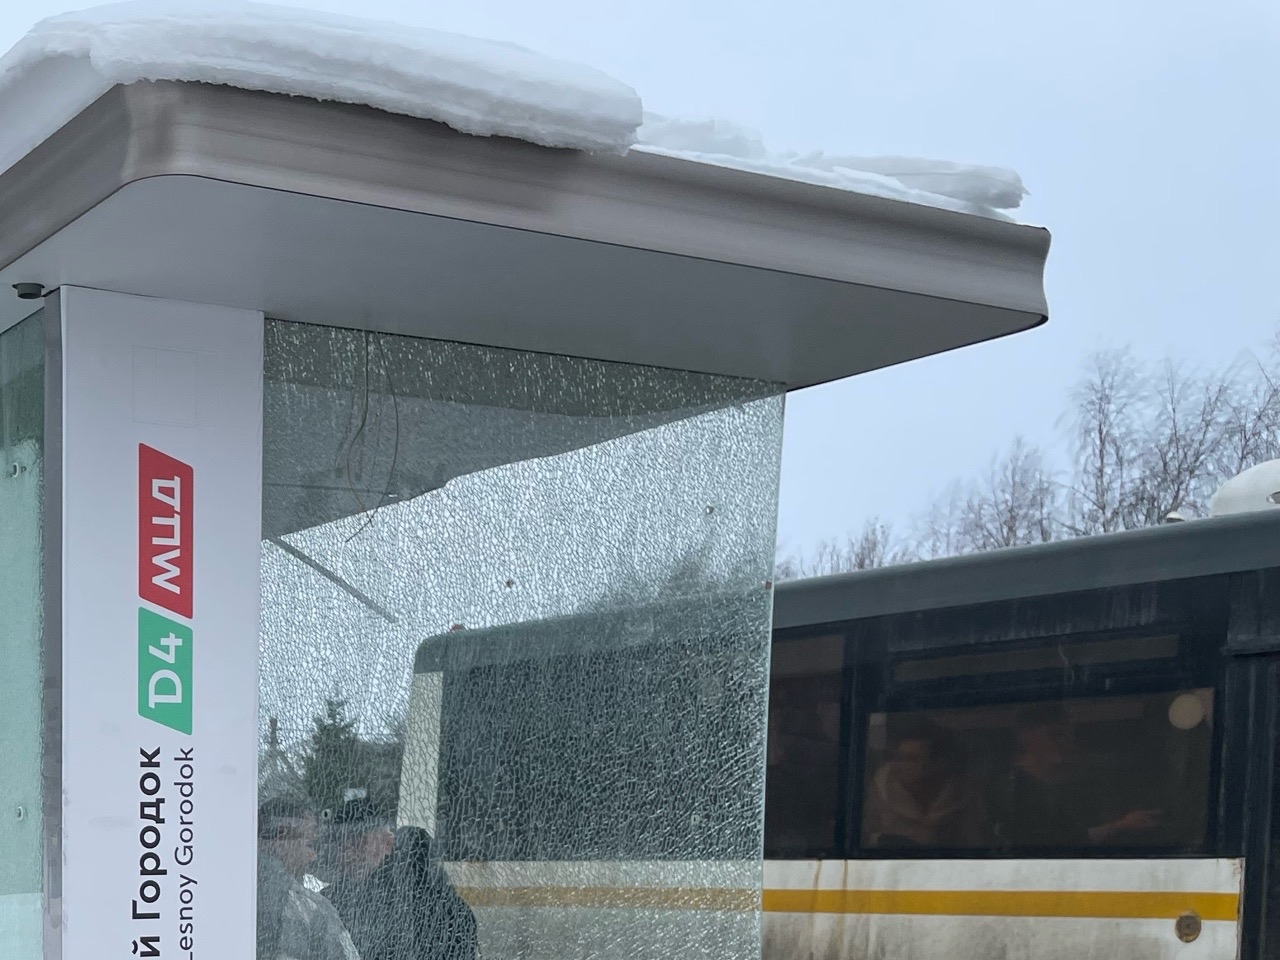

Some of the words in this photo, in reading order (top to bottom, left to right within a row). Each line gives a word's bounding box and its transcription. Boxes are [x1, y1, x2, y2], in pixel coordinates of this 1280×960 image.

[151, 475, 181, 595] МЦД
[148, 632, 183, 709] D4
[131, 746, 167, 920] Городок
[173, 747, 194, 866] Gorodok
